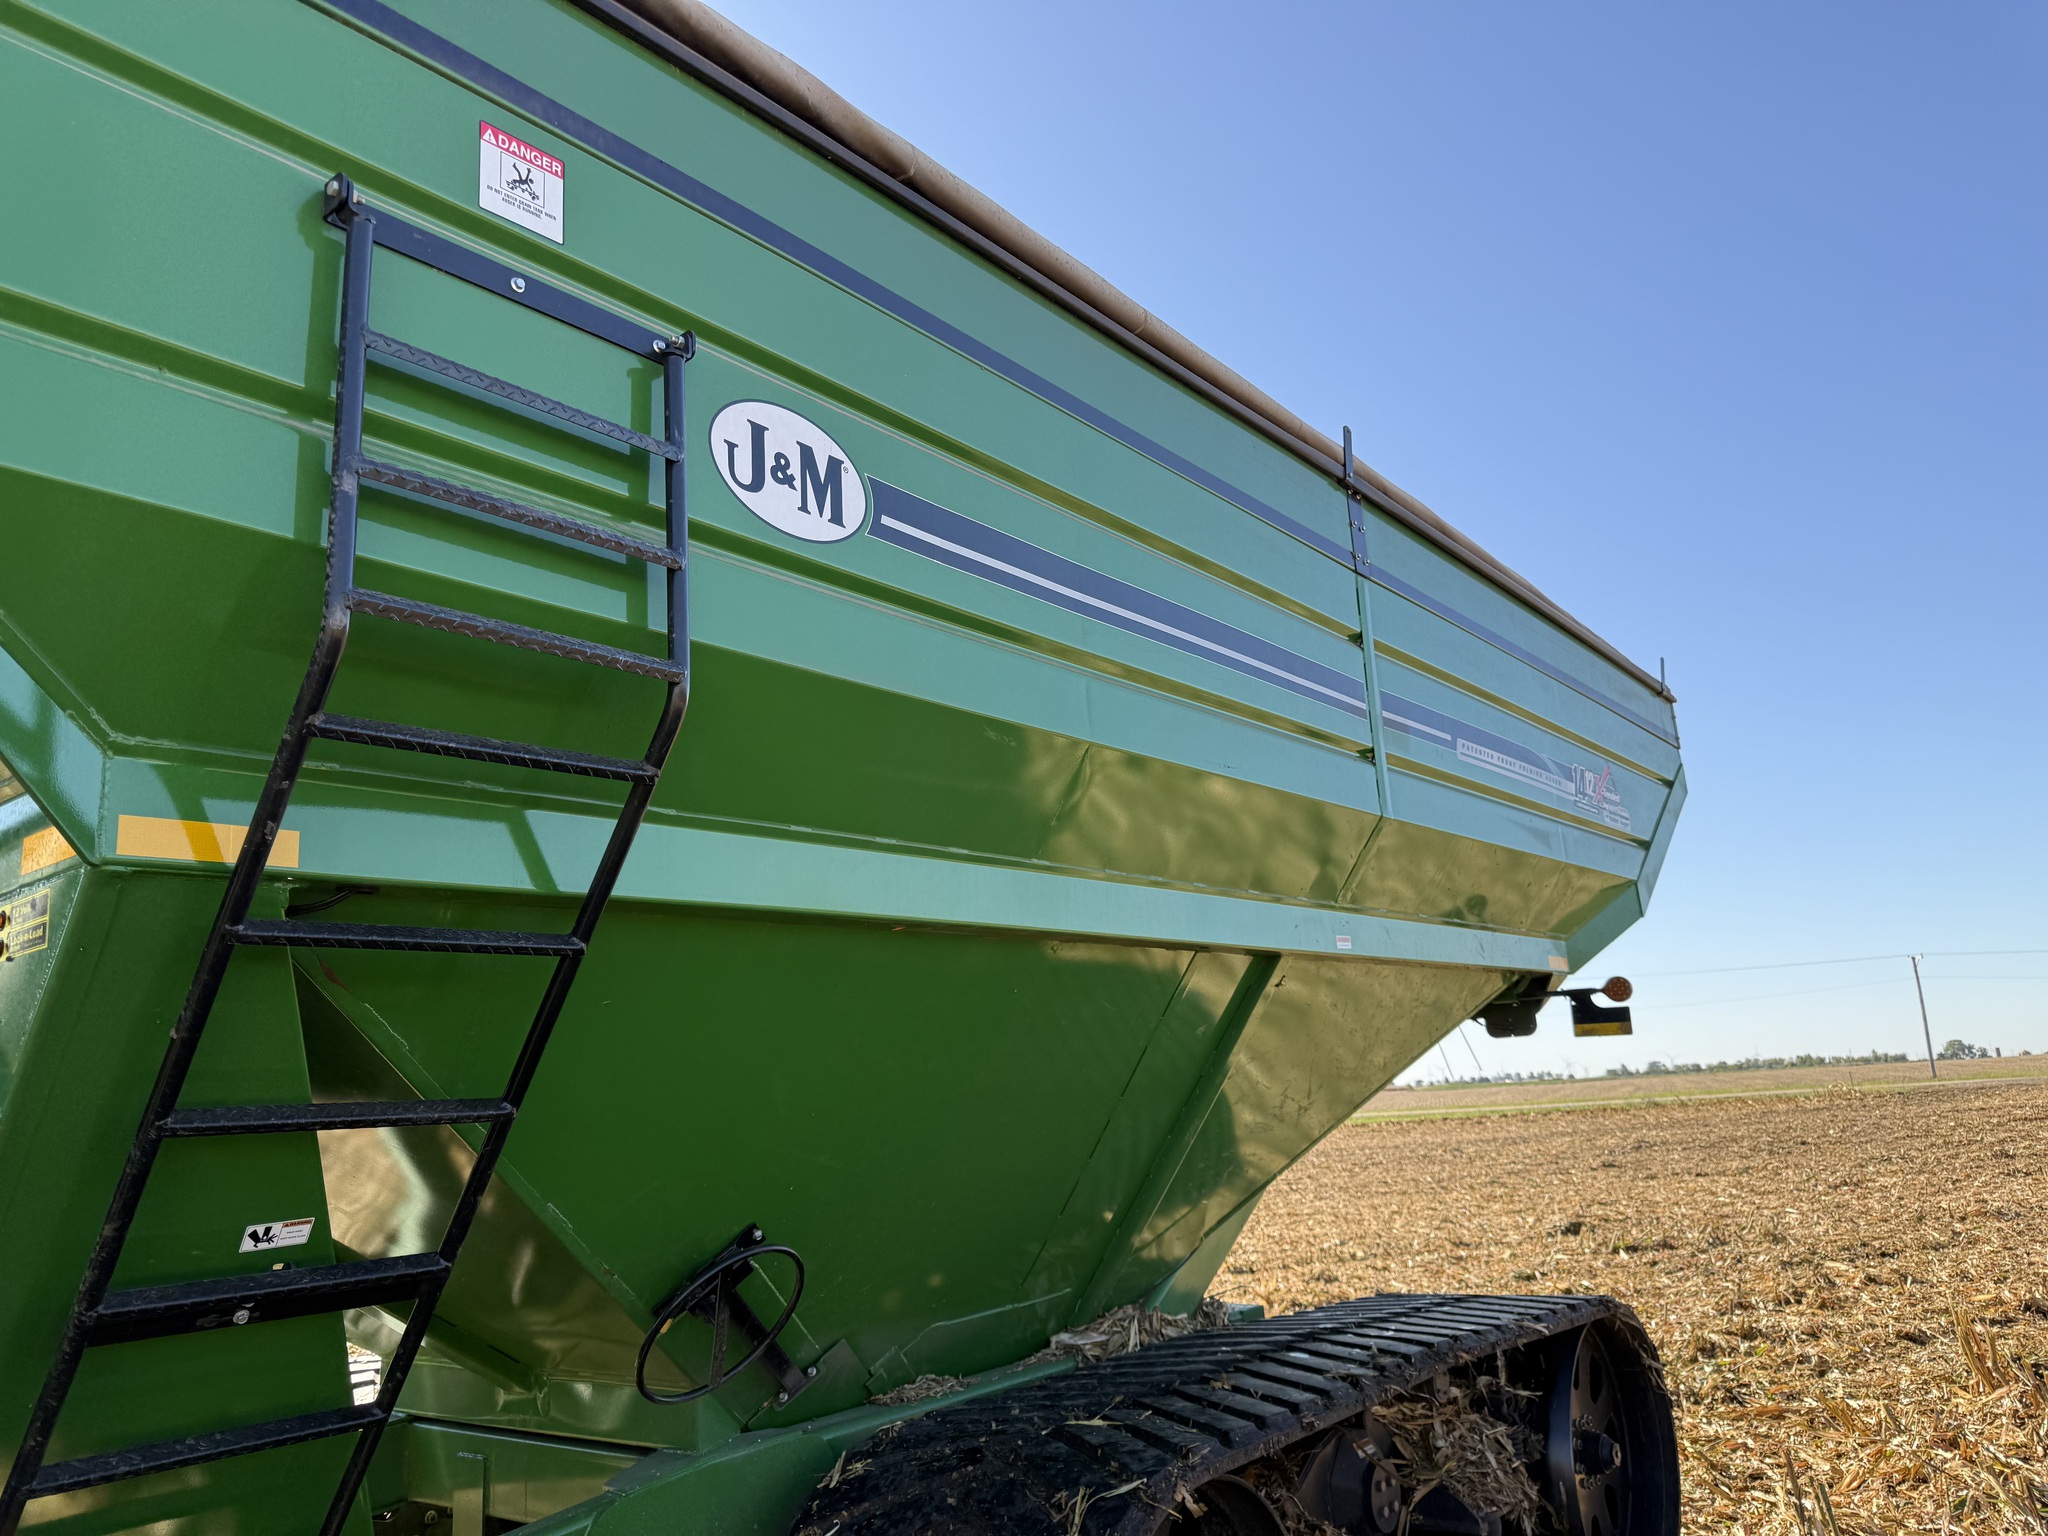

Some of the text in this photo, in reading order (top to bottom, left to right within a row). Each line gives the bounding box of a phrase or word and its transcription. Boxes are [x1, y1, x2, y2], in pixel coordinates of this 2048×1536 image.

[498, 134, 562, 176] DANGER
[494, 188, 503, 196] NOT
[504, 192, 518, 203] ENTER
[533, 205, 544, 214] TANK
[544, 212, 557, 221] WHEN
[502, 197, 516, 207] AUGER
[723, 418, 846, 529] J&M
[1461, 742, 1494, 760] PATENTED
